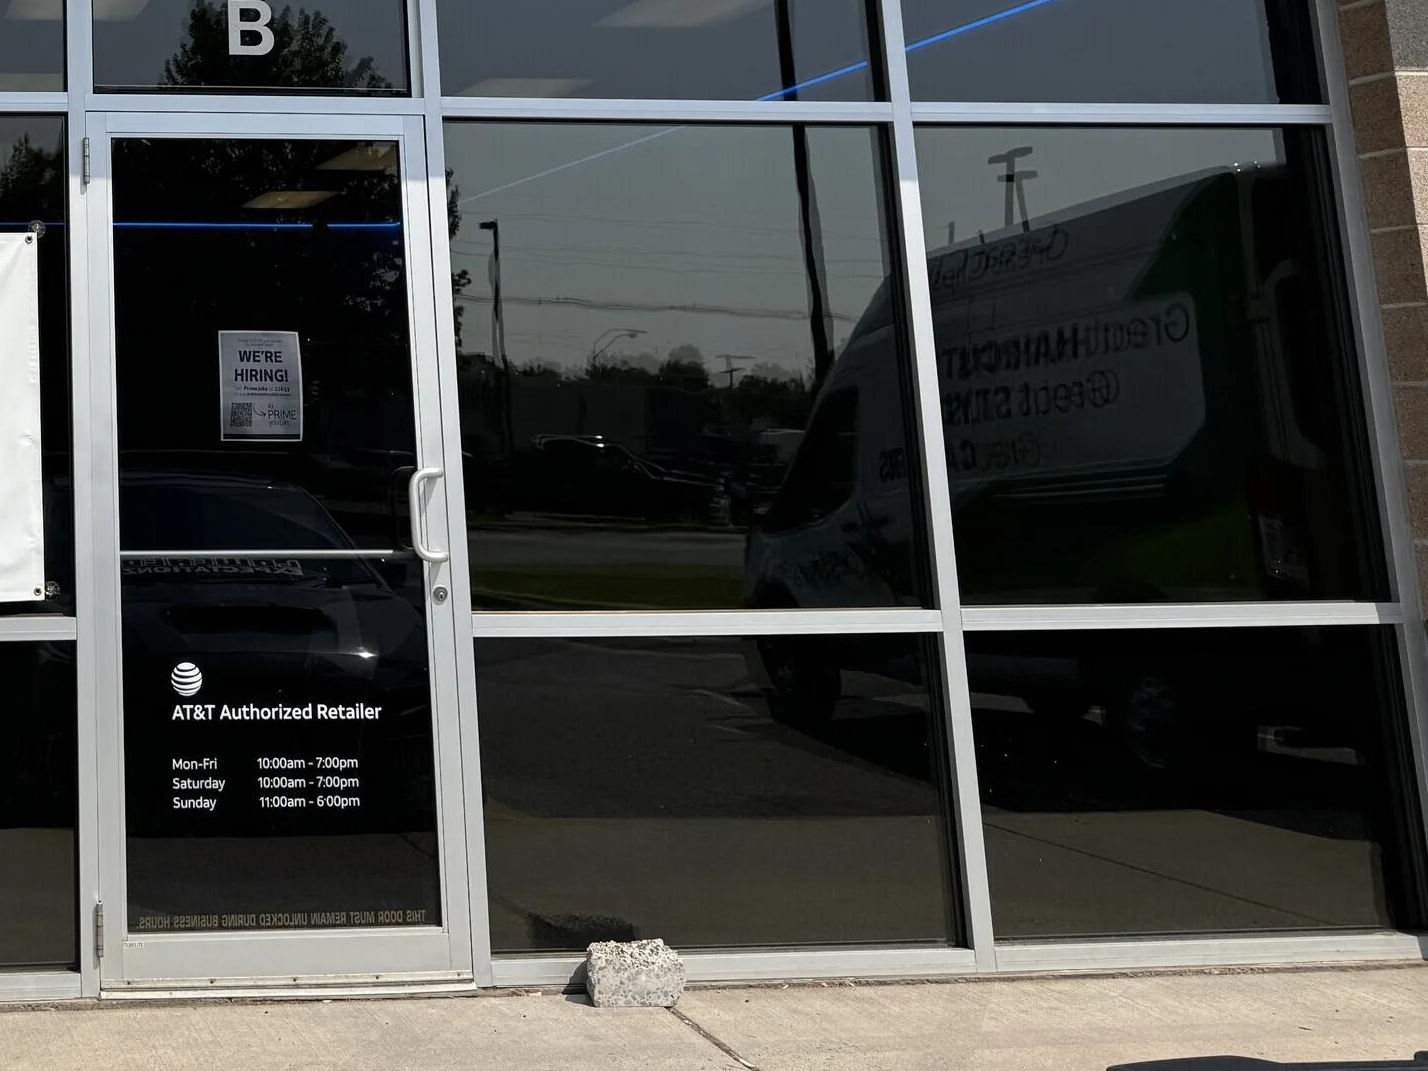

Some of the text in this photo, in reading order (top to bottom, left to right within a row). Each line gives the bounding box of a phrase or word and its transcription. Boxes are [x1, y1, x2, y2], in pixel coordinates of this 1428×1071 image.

[238, 350, 283, 363] WE'RE
[234, 368, 289, 382] HIRING!
[172, 703, 382, 720] AT&T Authorized Retailer
[172, 758, 218, 770] Mon-Fri
[257, 757, 306, 769] 10:00am
[316, 757, 359, 771] 7:00pm
[172, 777, 225, 792] Saturday
[257, 777, 306, 788] 10:00am
[316, 776, 360, 790] 7:00pm
[173, 796, 217, 811] Sunday
[259, 796, 306, 808] 11:00am
